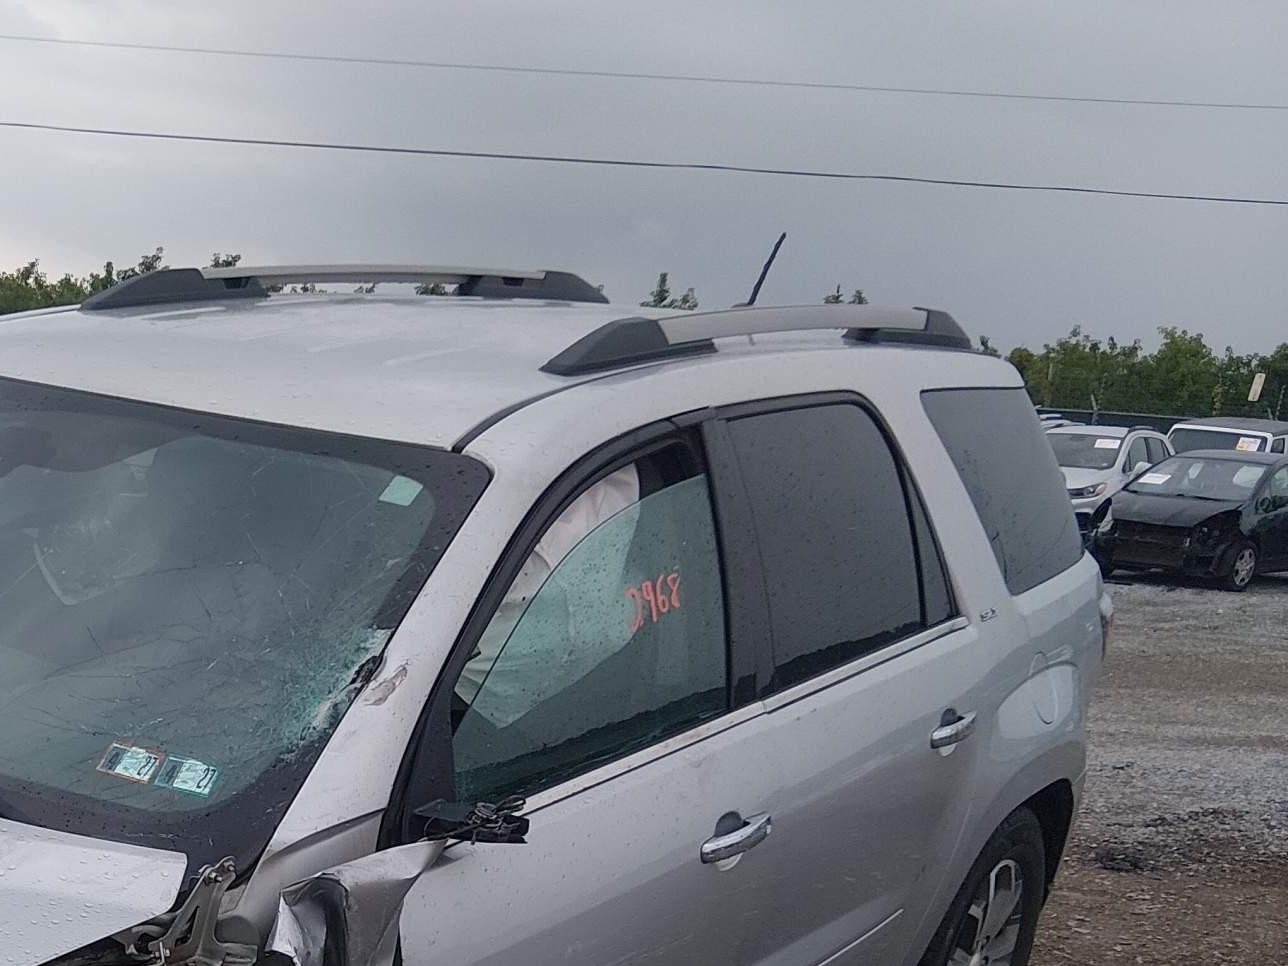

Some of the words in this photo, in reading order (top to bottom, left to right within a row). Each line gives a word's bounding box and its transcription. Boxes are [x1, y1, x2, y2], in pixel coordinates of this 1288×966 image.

[624, 569, 681, 632] 2968
[136, 755, 159, 777] 27
[195, 766, 217, 789] 27
